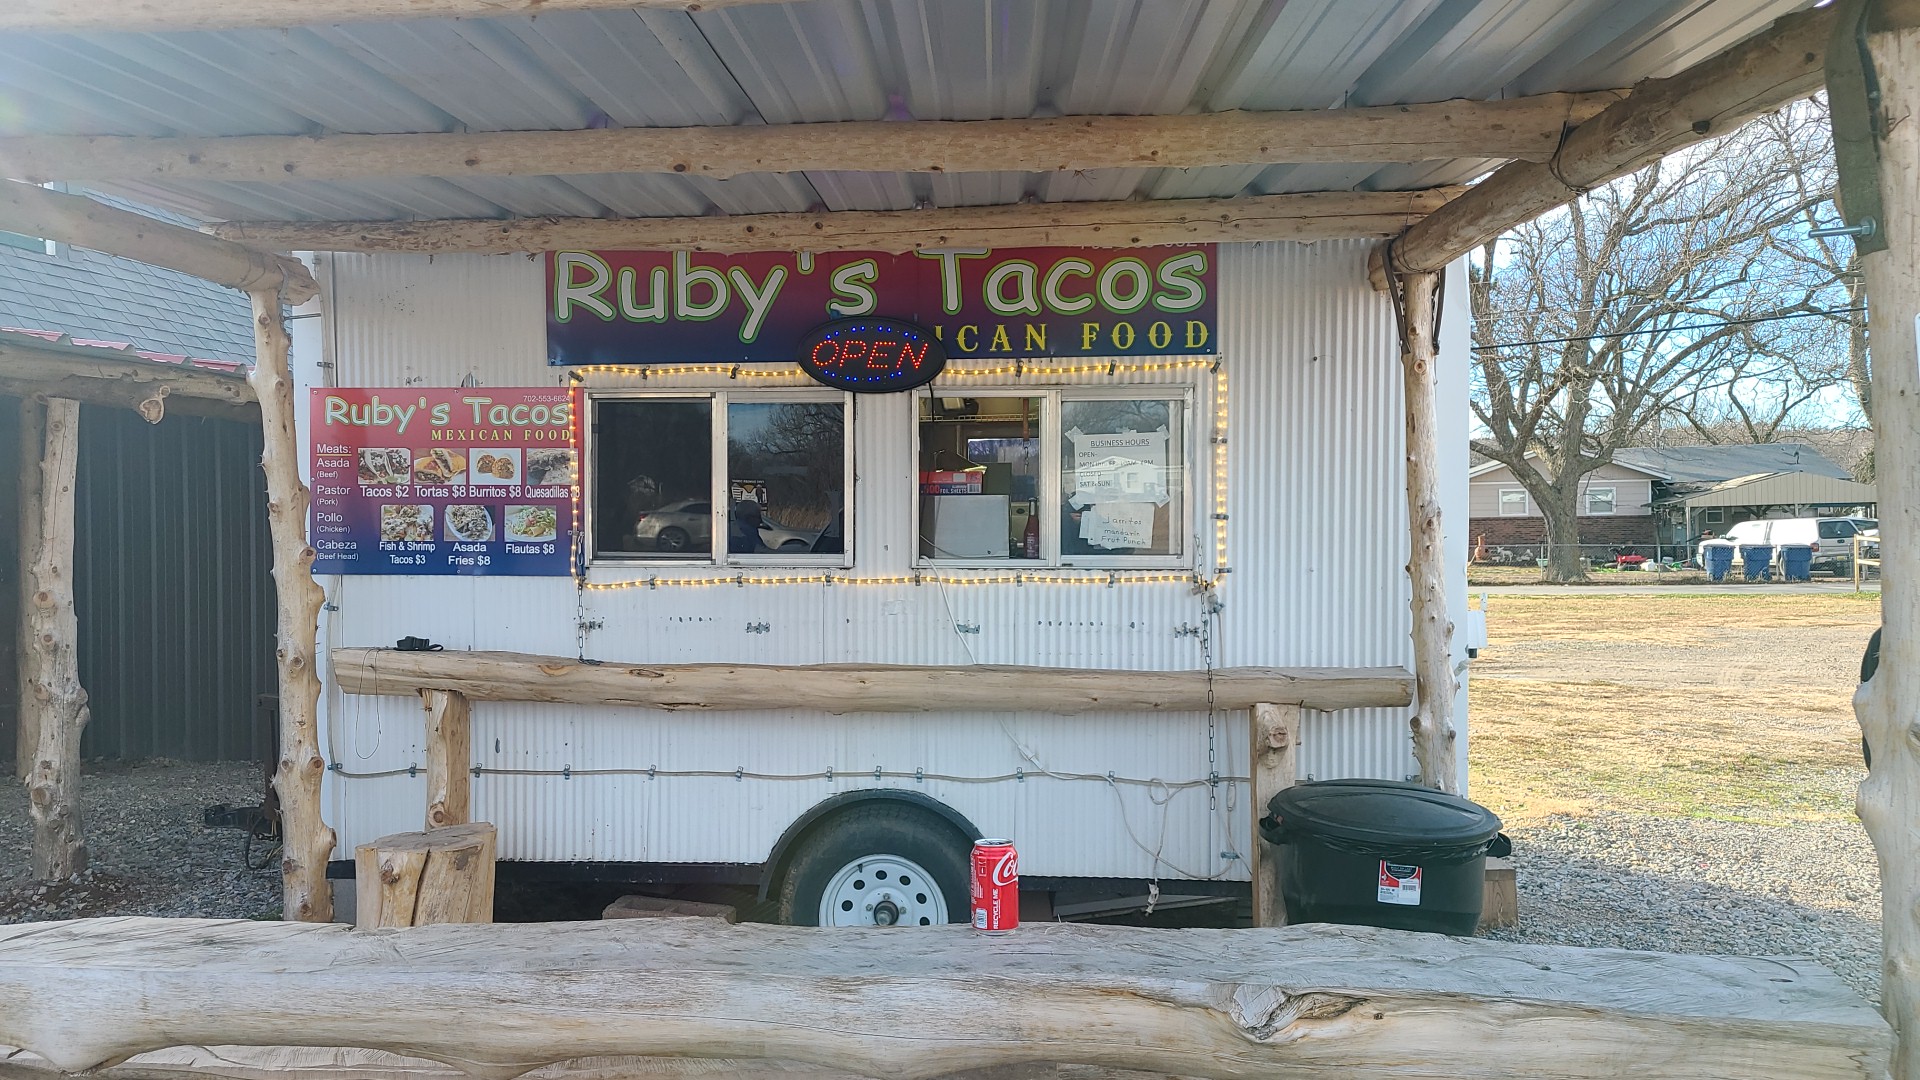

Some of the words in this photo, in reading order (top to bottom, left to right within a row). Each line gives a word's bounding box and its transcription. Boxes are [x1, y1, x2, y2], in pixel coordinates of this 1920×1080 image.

[554, 249, 879, 343] Ruby's
[913, 247, 1208, 316] Tacos
[1081, 320, 1209, 350] FOOD
[811, 340, 929, 369] OPEN
[325, 395, 450, 434] Ruby's
[462, 396, 569, 426] Tacos
[431, 429, 512, 441] MEXICAN
[523, 429, 570, 441] FOOD
[316, 443, 352, 454] Meats:
[1090, 439, 1124, 447] BUSINESS
[1125, 438, 1150, 446] HOURS
[316, 457, 350, 468] Asada
[316, 470, 339, 479] (Beef)
[316, 485, 351, 495] Pastor
[359, 485, 392, 498] Tacos
[395, 484, 409, 499] $2
[414, 485, 449, 498] Tortas
[452, 485, 466, 499] $8
[469, 485, 507, 498] Burritos
[509, 485, 522, 499] $8
[524, 485, 569, 499] Quesadillas
[316, 498, 339, 507] (Pork)
[316, 512, 343, 522] Pollo
[316, 525, 351, 534] (Chicken)
[316, 539, 357, 550] Cabeza
[1123, 536, 1146, 545] Punch
[379, 541, 397, 551] Fish
[398, 541, 405, 551] &
[406, 541, 436, 553] Shrimp
[452, 542, 487, 552] Asada
[505, 543, 541, 554] Flautas
[542, 542, 555, 556] $8
[316, 552, 336, 561] (Beef
[337, 552, 359, 561] Head)
[389, 554, 414, 564] Tacos
[415, 553, 426, 566] $3
[448, 554, 475, 565] Fries
[477, 554, 491, 567] $8
